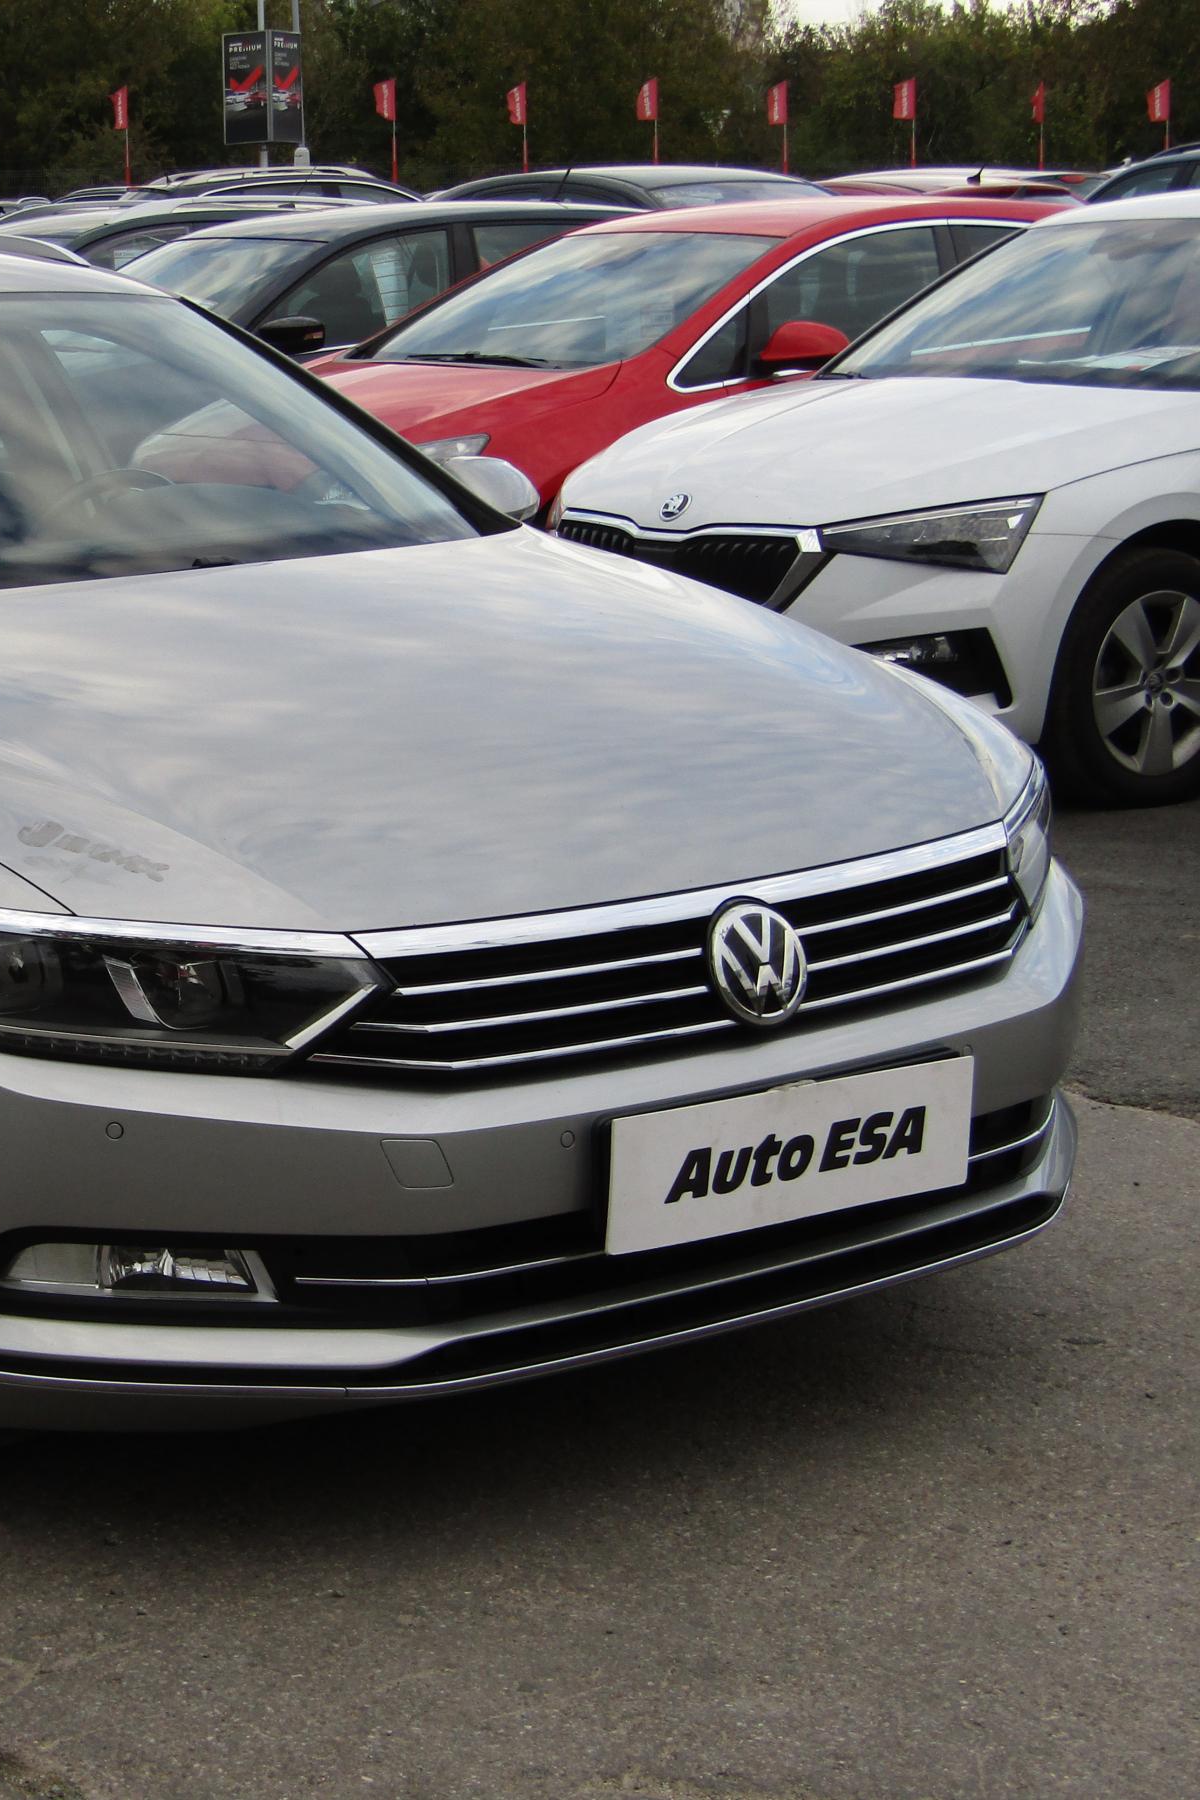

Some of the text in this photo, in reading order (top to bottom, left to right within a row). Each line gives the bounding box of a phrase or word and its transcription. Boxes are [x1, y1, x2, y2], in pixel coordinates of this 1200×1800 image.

[711, 904, 807, 1025] VW
[664, 1105, 926, 1204] Auto ESA
